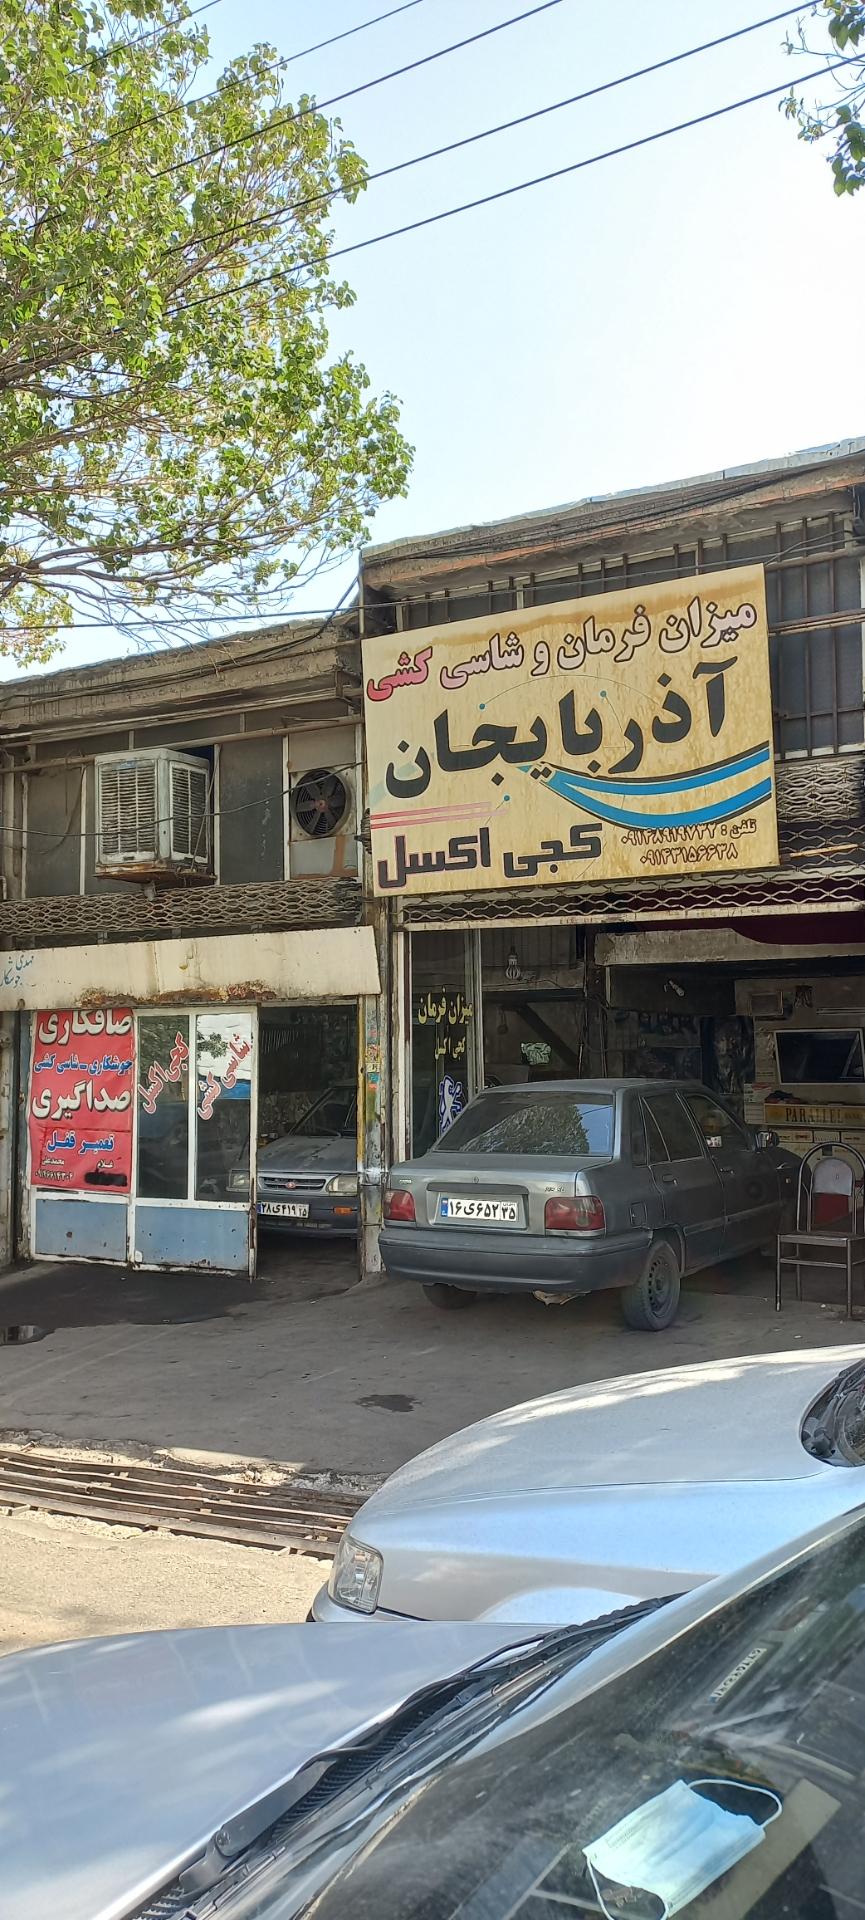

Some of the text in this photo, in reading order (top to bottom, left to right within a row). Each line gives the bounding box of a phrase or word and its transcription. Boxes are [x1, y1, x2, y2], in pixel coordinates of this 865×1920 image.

[367, 596, 758, 702] میزان فرمان و شاسی کشی
[385, 656, 738, 798] آذربایجان
[730, 818, 757, 840] تلفن
[376, 822, 603, 889] کجی اکسل
[417, 986, 473, 1025] میزان فرمان
[38, 1009, 133, 1046] صافکاری
[34, 1052, 57, 1074] کشی
[56, 1053, 80, 1075] شاسی
[87, 1055, 134, 1076] جوشکاری
[137, 1030, 189, 1115] کجی اکسل
[197, 1033, 251, 1121] شاسی کشی
[31, 1079, 132, 1120] صداگیری
[46, 1130, 116, 1155] تعمیر قفل
